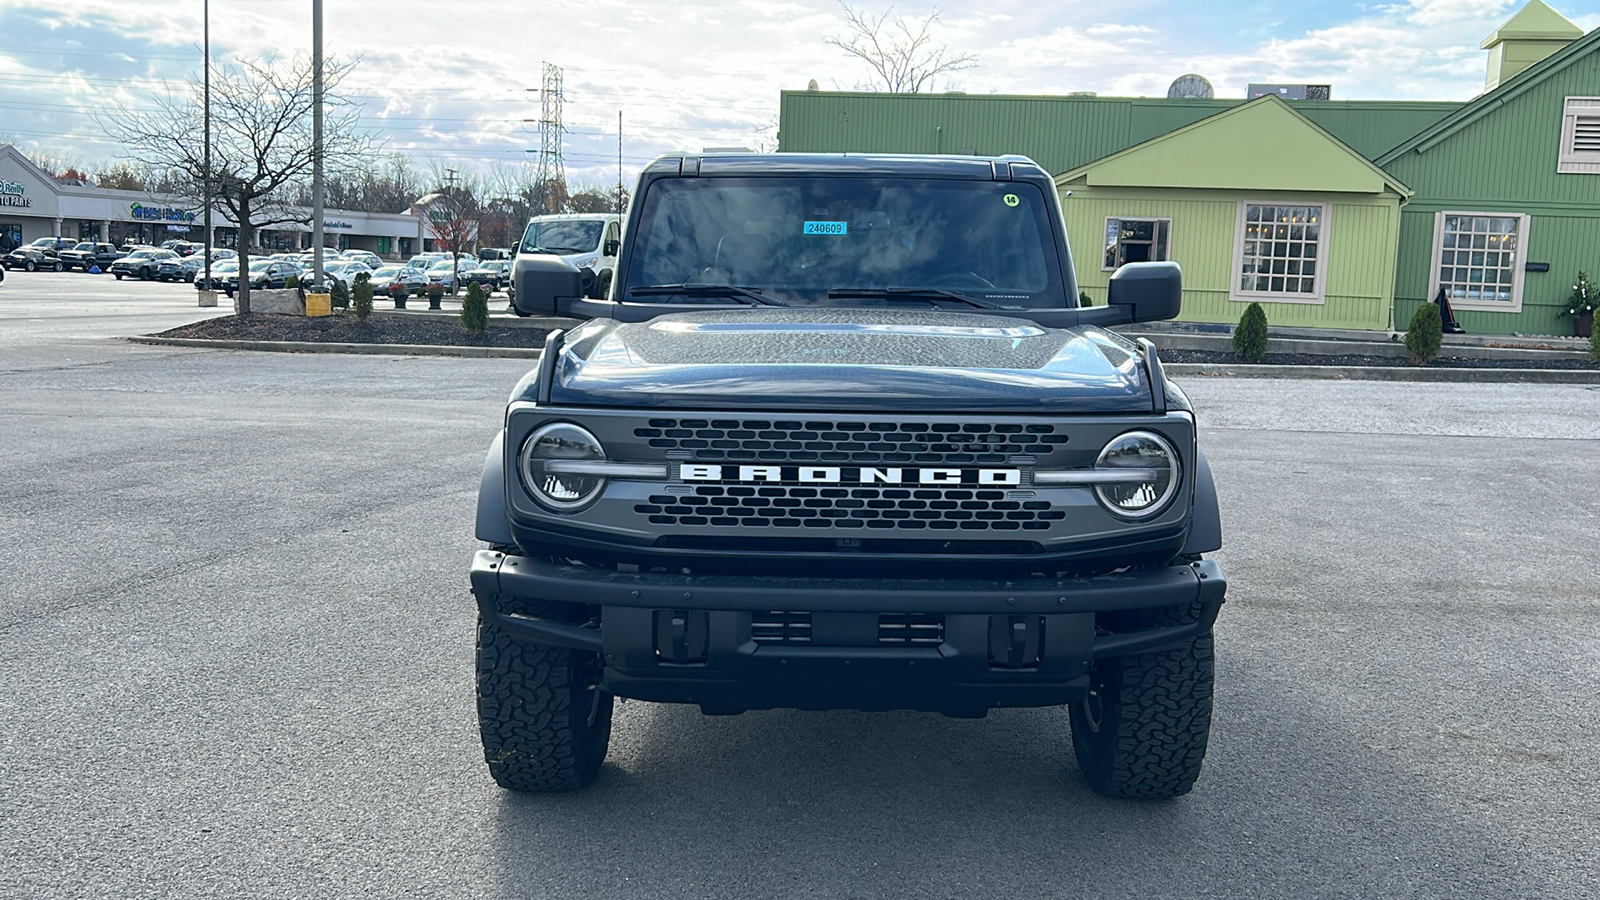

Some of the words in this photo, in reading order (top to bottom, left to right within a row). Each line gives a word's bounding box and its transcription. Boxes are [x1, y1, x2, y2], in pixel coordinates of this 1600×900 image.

[11, 197, 32, 207] PARTS
[1006, 196, 1016, 204] 14
[808, 223, 842, 234] 240609
[680, 464, 1020, 485] BRONCO
